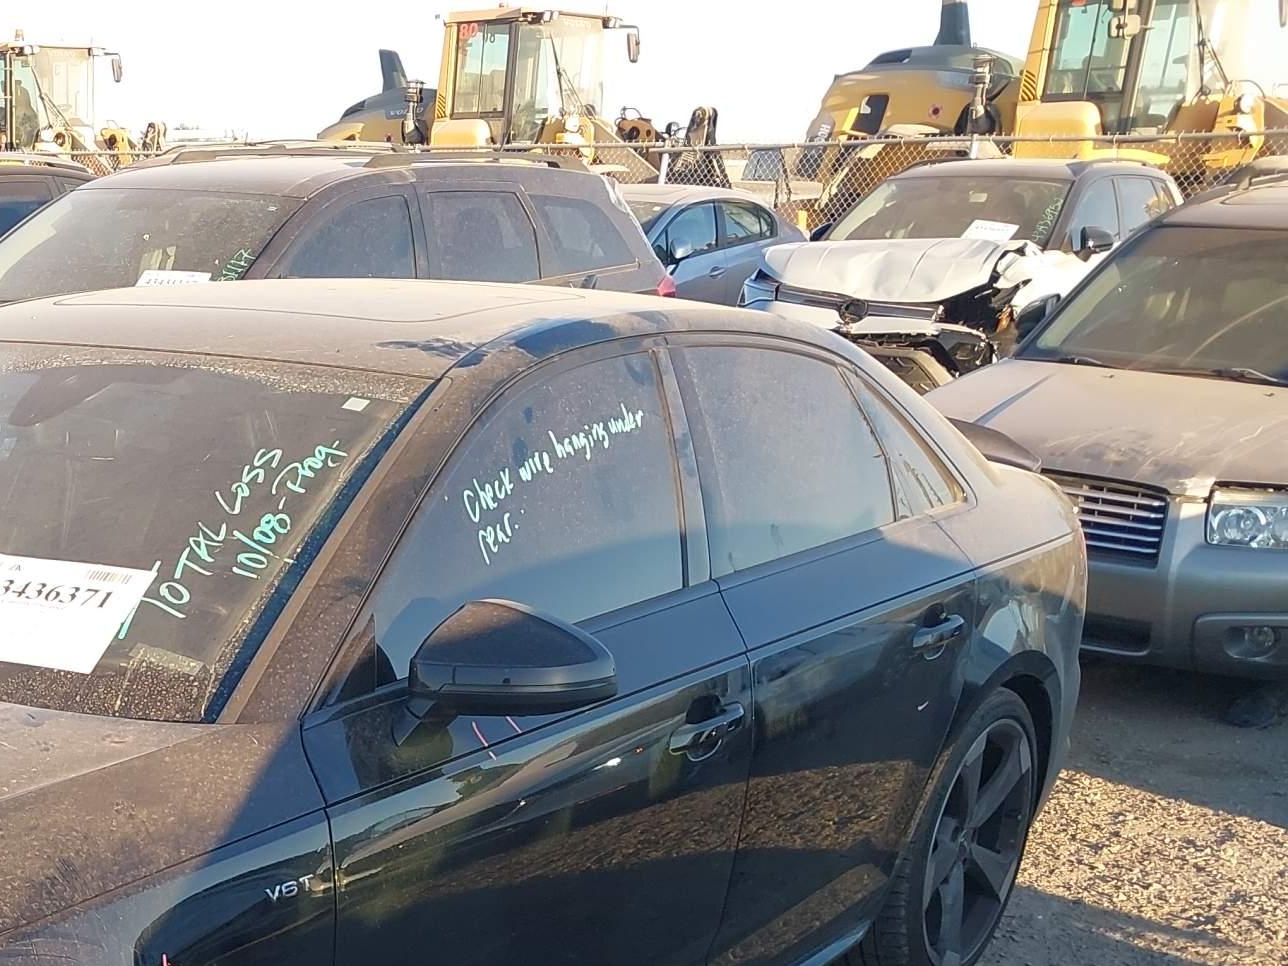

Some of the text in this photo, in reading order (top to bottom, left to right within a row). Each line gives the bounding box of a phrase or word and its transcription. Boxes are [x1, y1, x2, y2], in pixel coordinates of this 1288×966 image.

[463, 467, 515, 523] Check
[548, 420, 609, 461] hanging
[608, 402, 644, 436] under
[264, 873, 314, 902] V6T
